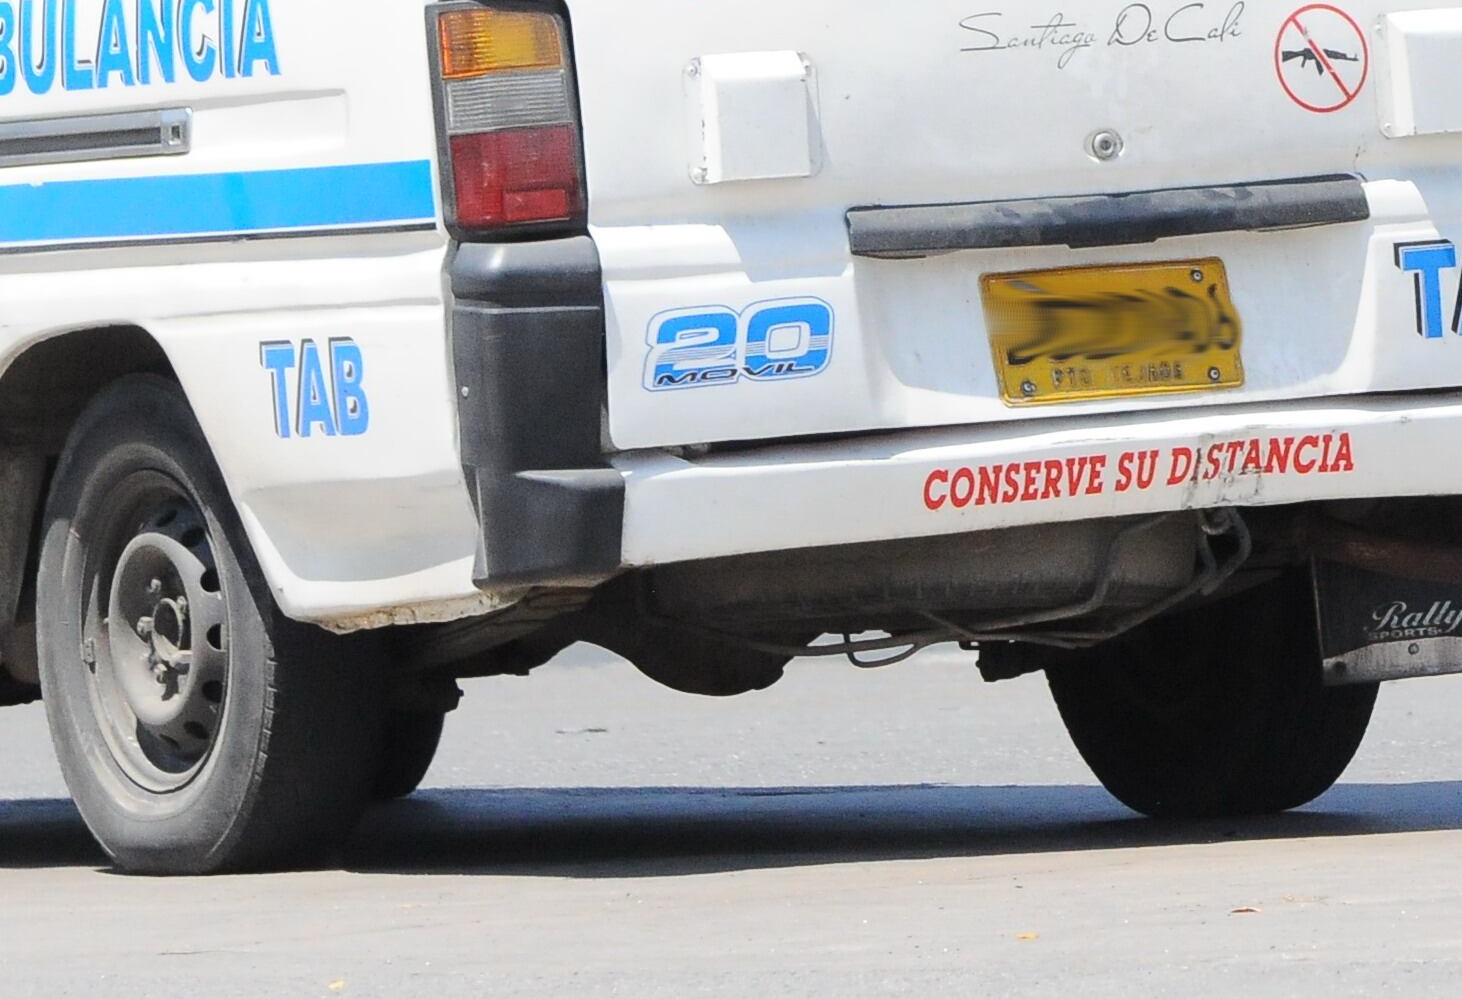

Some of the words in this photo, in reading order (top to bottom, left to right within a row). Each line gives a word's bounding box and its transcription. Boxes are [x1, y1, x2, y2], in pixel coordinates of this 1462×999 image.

[959, 12, 1096, 69] Santiago
[1107, 3, 1159, 47] De
[1164, 1, 1245, 42] Cali
[645, 296, 834, 391] 20
[656, 362, 814, 386] MOVIL
[260, 337, 369, 438] TAB
[924, 454, 1107, 511] CONSERVE
[1114, 449, 1159, 491] SU
[1166, 432, 1354, 486] DISTANCIA
